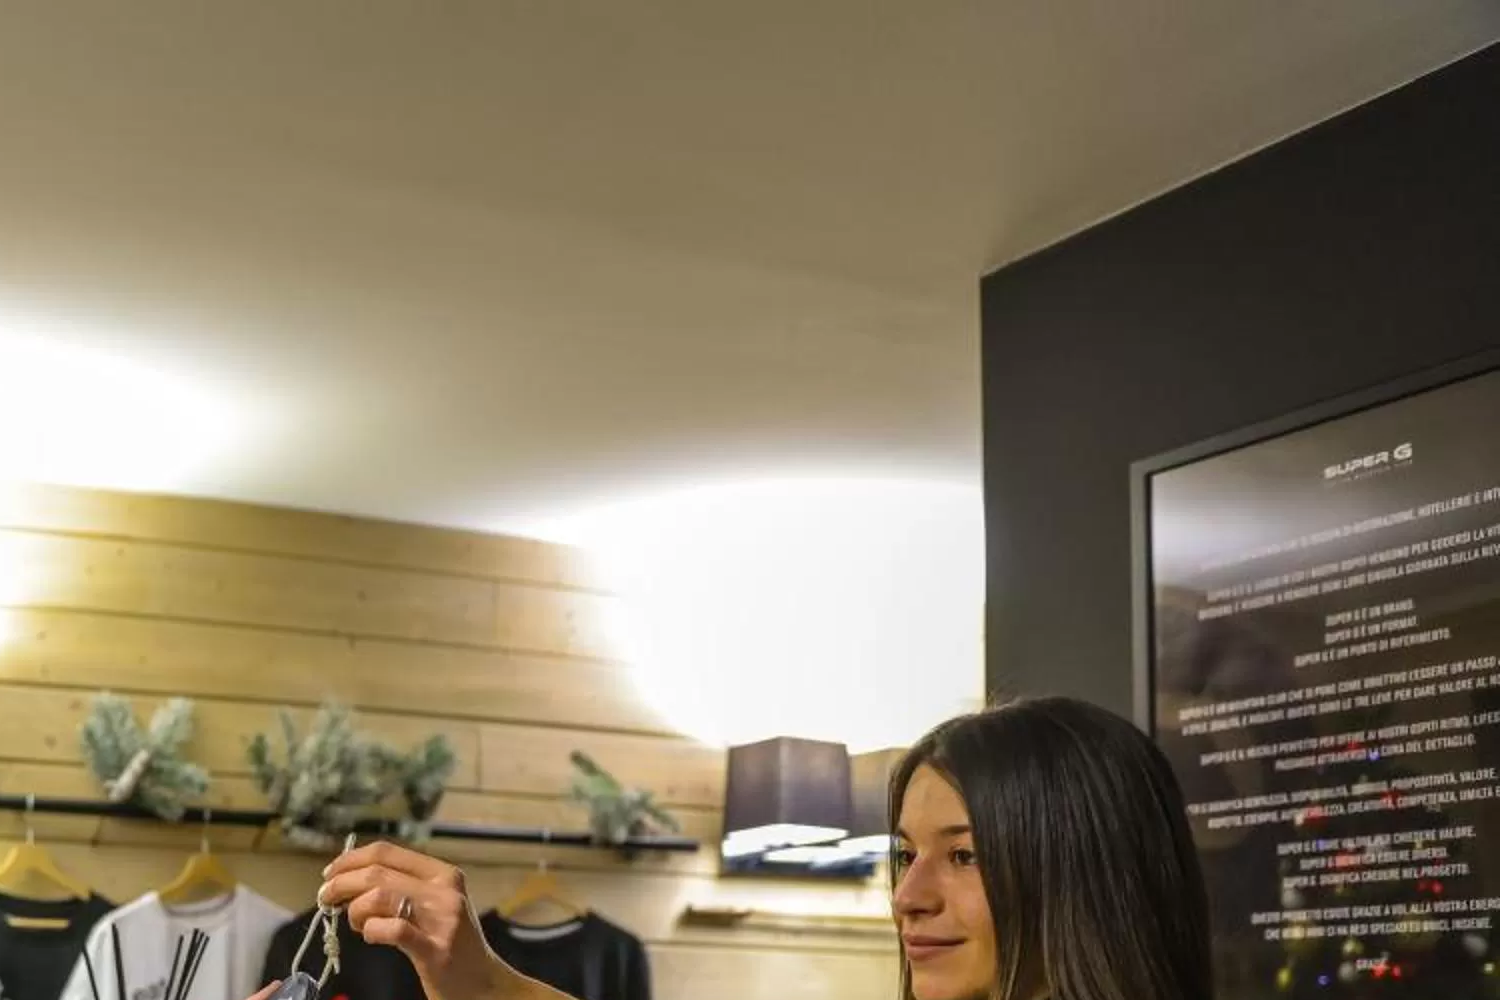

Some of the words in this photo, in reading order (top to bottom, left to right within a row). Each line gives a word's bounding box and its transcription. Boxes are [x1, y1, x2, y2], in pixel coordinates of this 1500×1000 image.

[1324, 451, 1389, 480] SUPER
[1393, 442, 1412, 460] G
[1450, 547, 1478, 565] SULLA
[1465, 655, 1495, 671] PASSO
